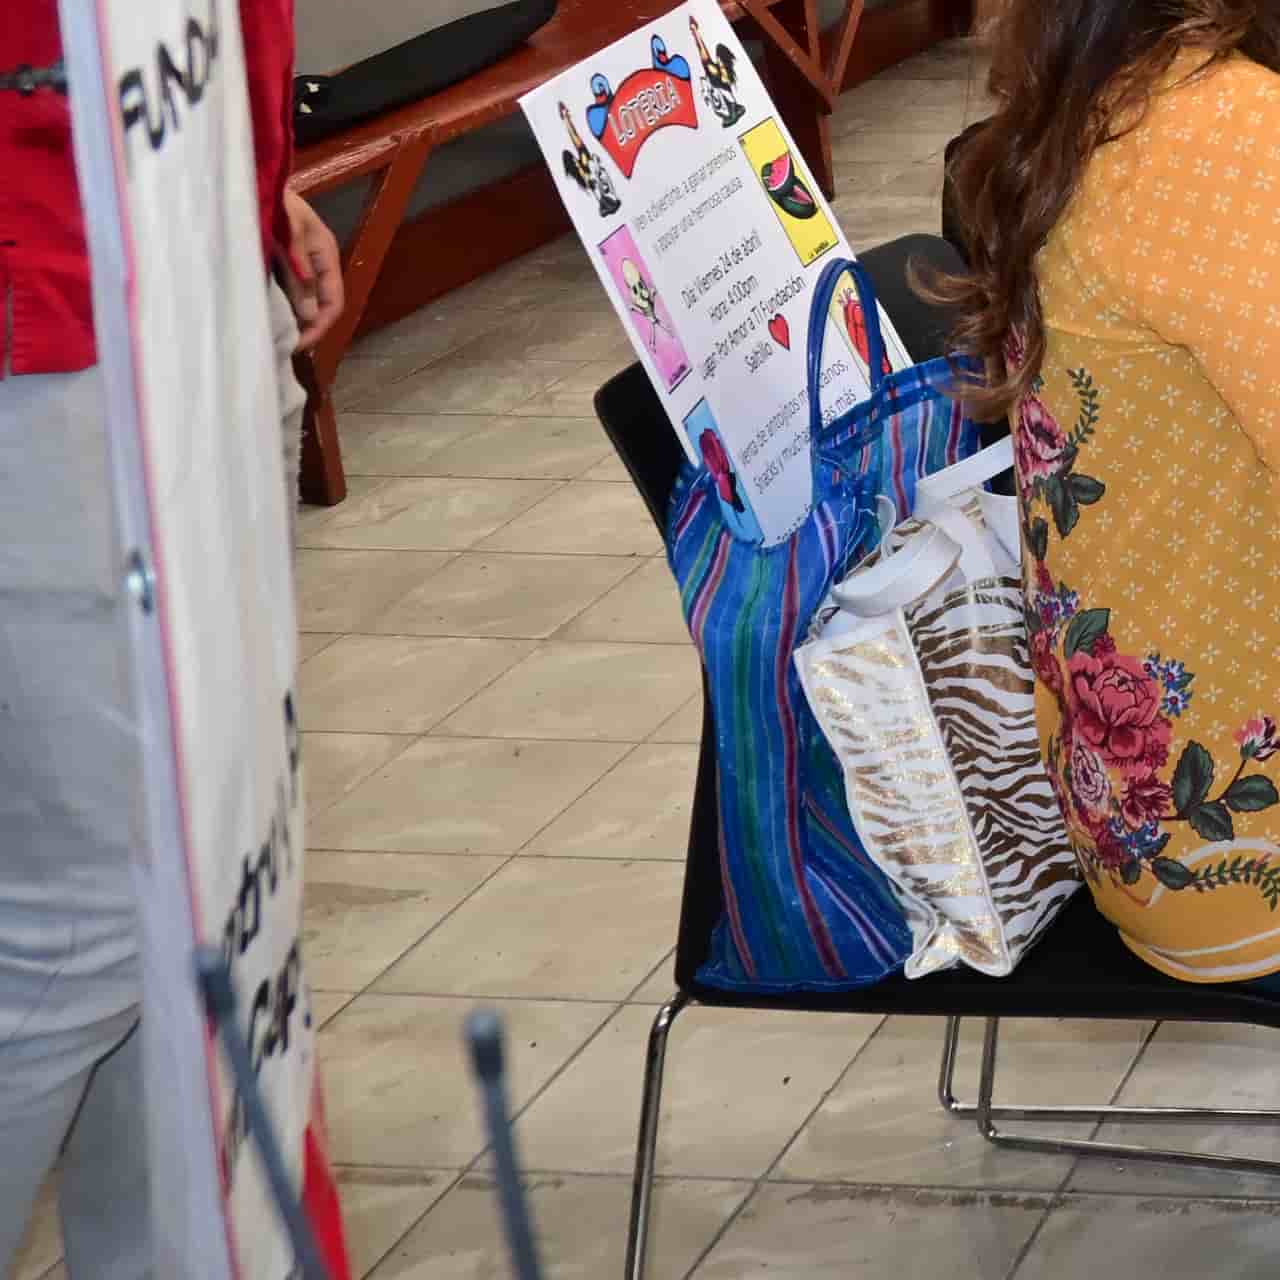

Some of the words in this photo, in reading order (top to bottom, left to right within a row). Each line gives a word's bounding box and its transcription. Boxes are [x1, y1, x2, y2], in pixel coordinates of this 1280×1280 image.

[729, 246, 743, 265] de
[758, 269, 805, 319] Fundación
[754, 428, 768, 447] de
